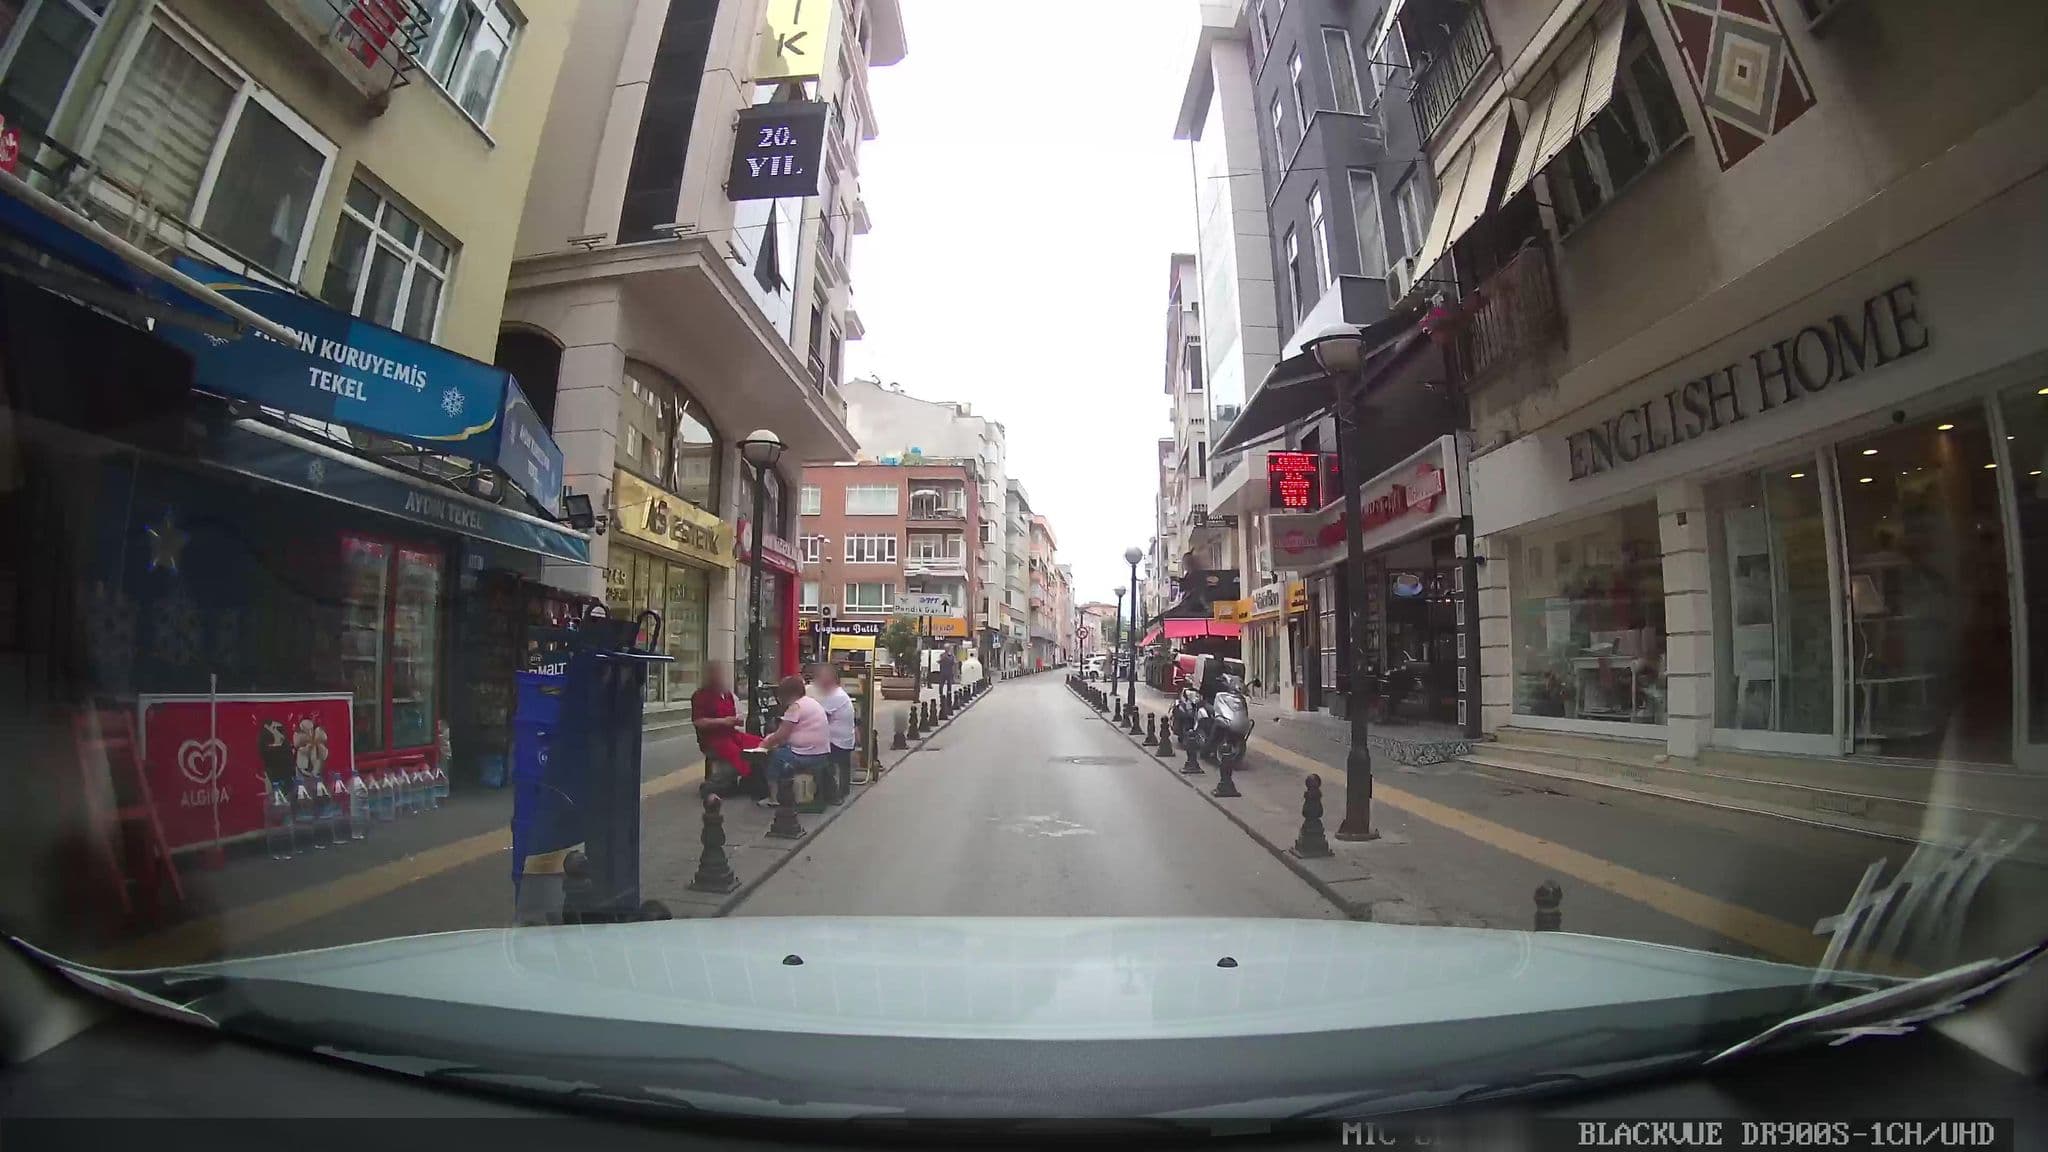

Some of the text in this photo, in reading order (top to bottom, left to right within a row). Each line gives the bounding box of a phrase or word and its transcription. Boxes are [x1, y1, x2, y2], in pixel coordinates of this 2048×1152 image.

[758, 126, 798, 147] 20.
[746, 155, 803, 177] YIL
[320, 338, 428, 393] KURUYEMİŞ
[1565, 280, 1930, 482] ENGLISH HOME
[309, 367, 367, 401] TEKEL
